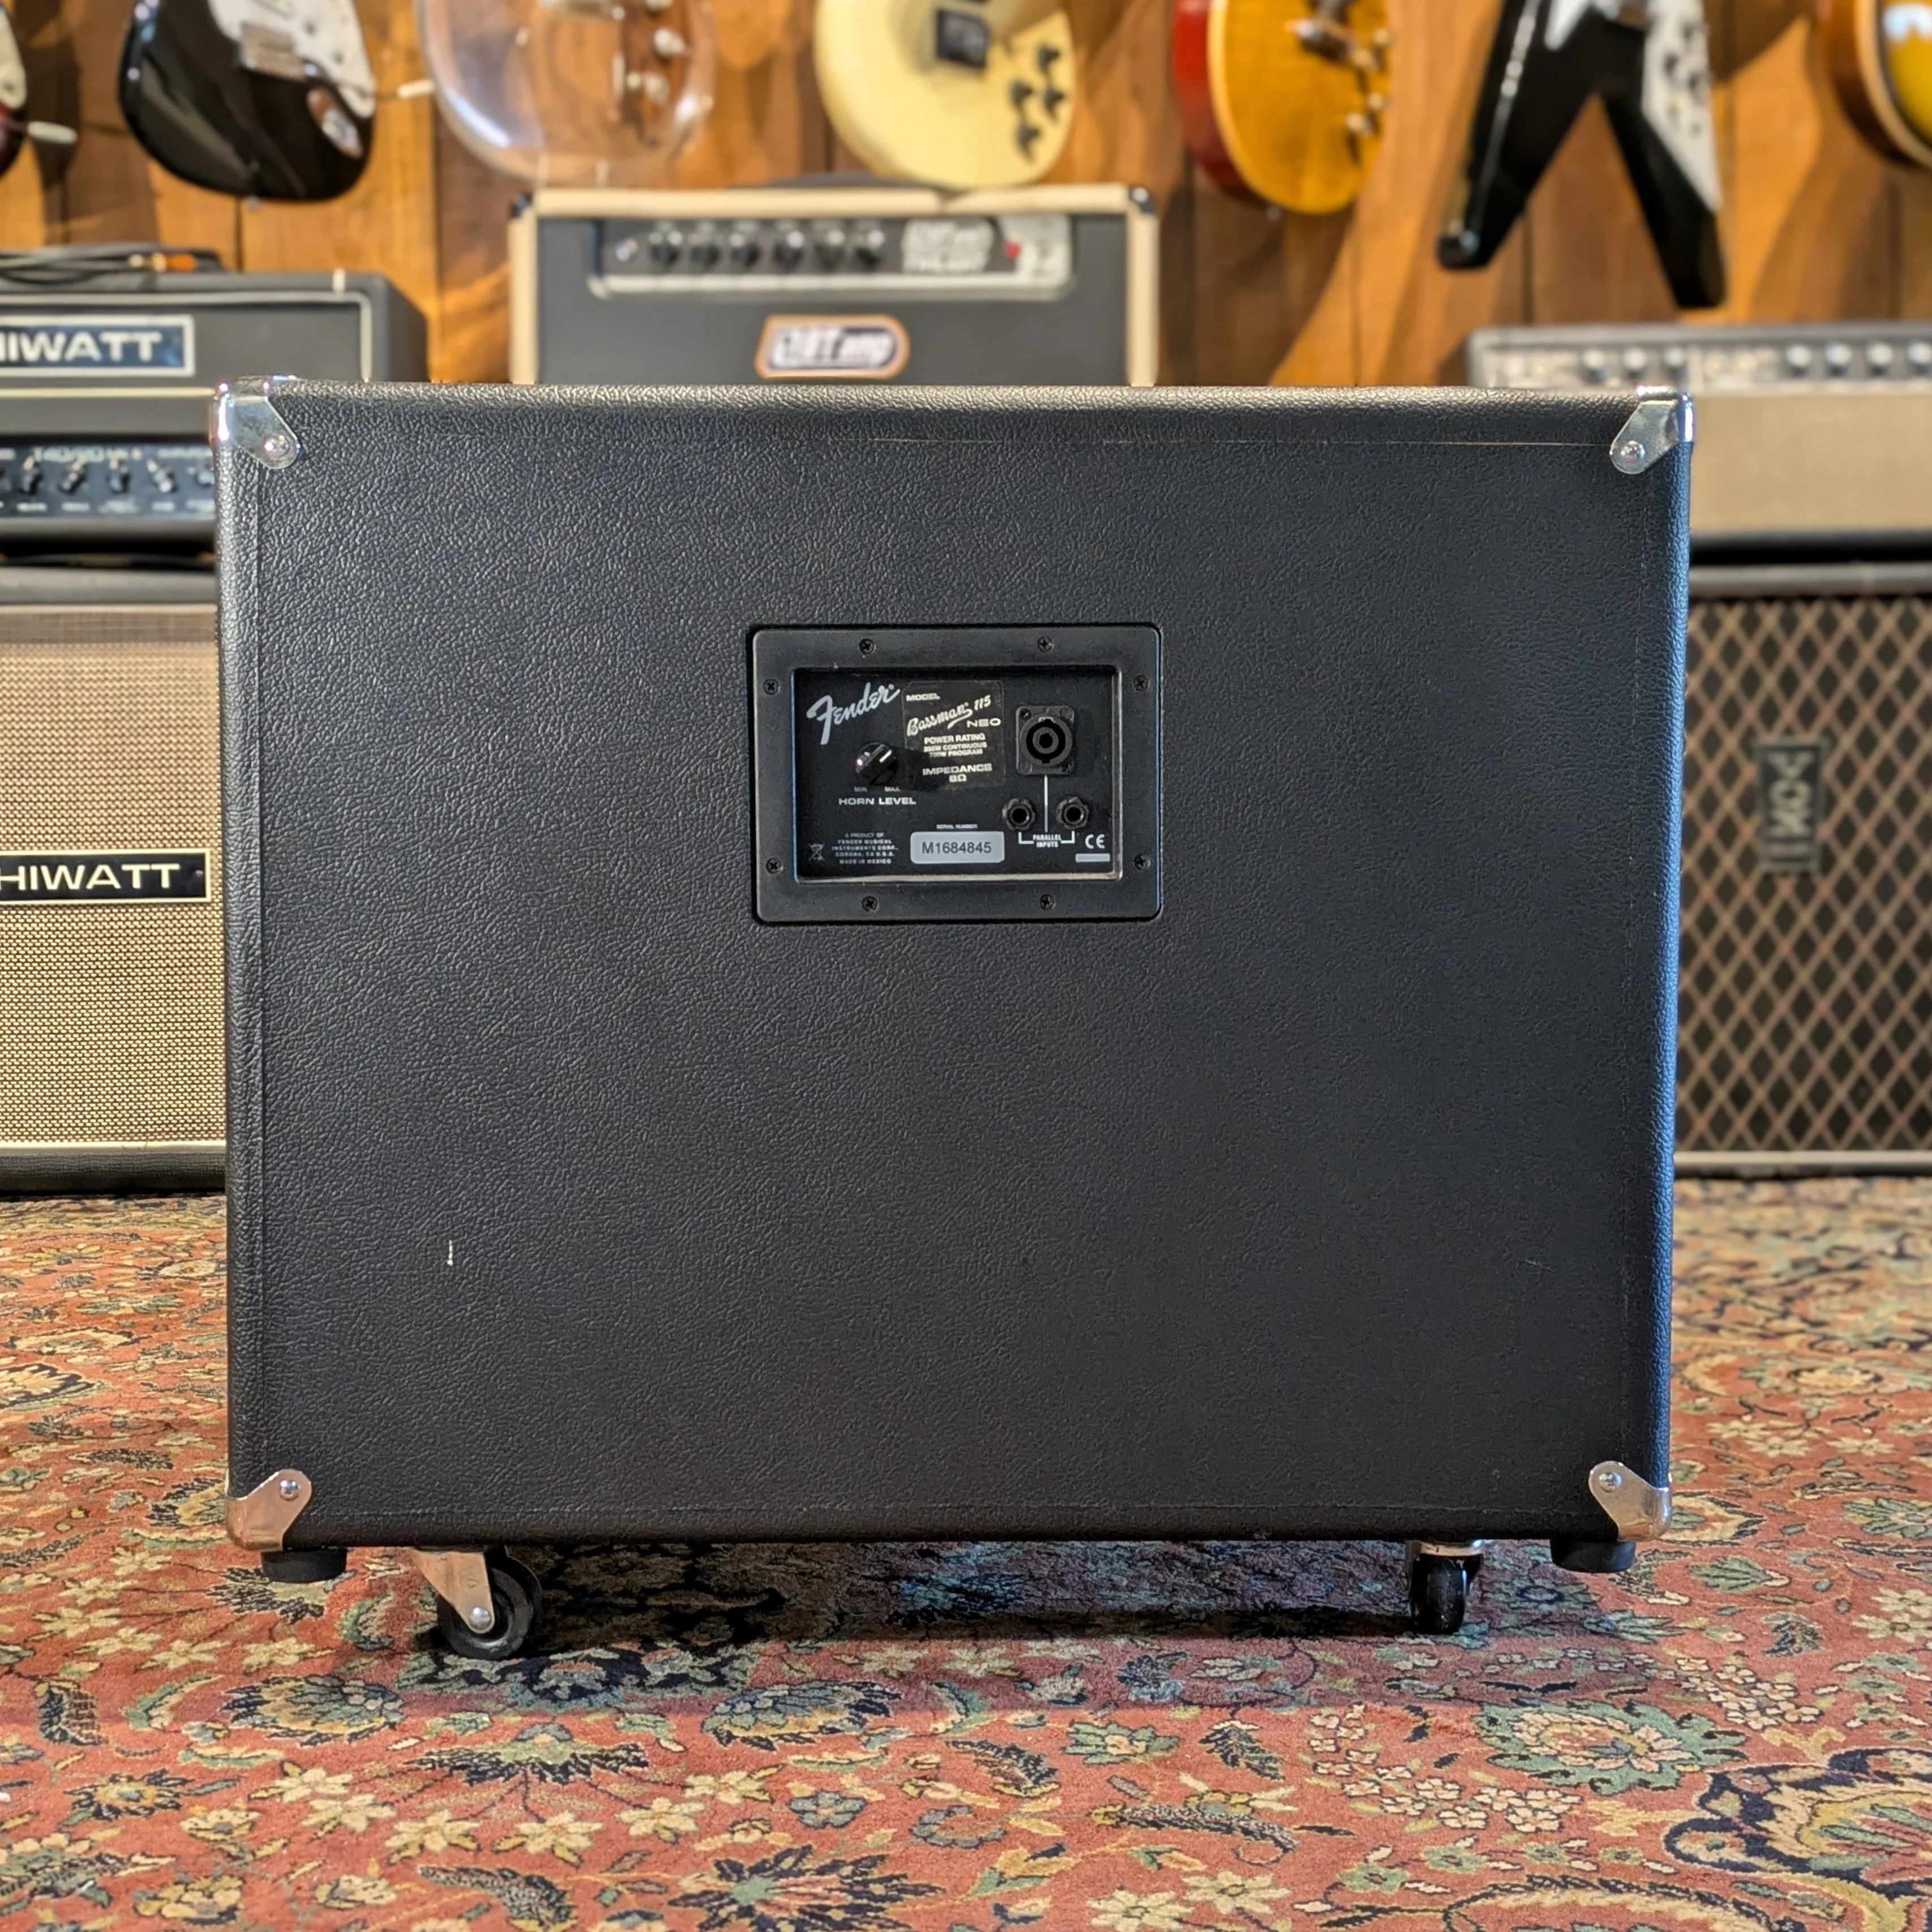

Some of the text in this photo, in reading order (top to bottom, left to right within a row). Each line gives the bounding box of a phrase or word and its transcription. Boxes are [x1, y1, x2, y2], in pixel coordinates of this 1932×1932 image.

[0, 332, 162, 362] IWATT
[906, 693, 940, 701] MODEL
[806, 682, 901, 745] Fender
[907, 695, 991, 736] Bassman 115
[966, 718, 1001, 728] NEO
[924, 733, 986, 744] POWER RATING
[943, 742, 987, 750] CONTINUOUS
[923, 763, 992, 776] IMPEDANCE
[922, 842, 992, 854] M1684845
[0, 864, 181, 890] HIWATT
